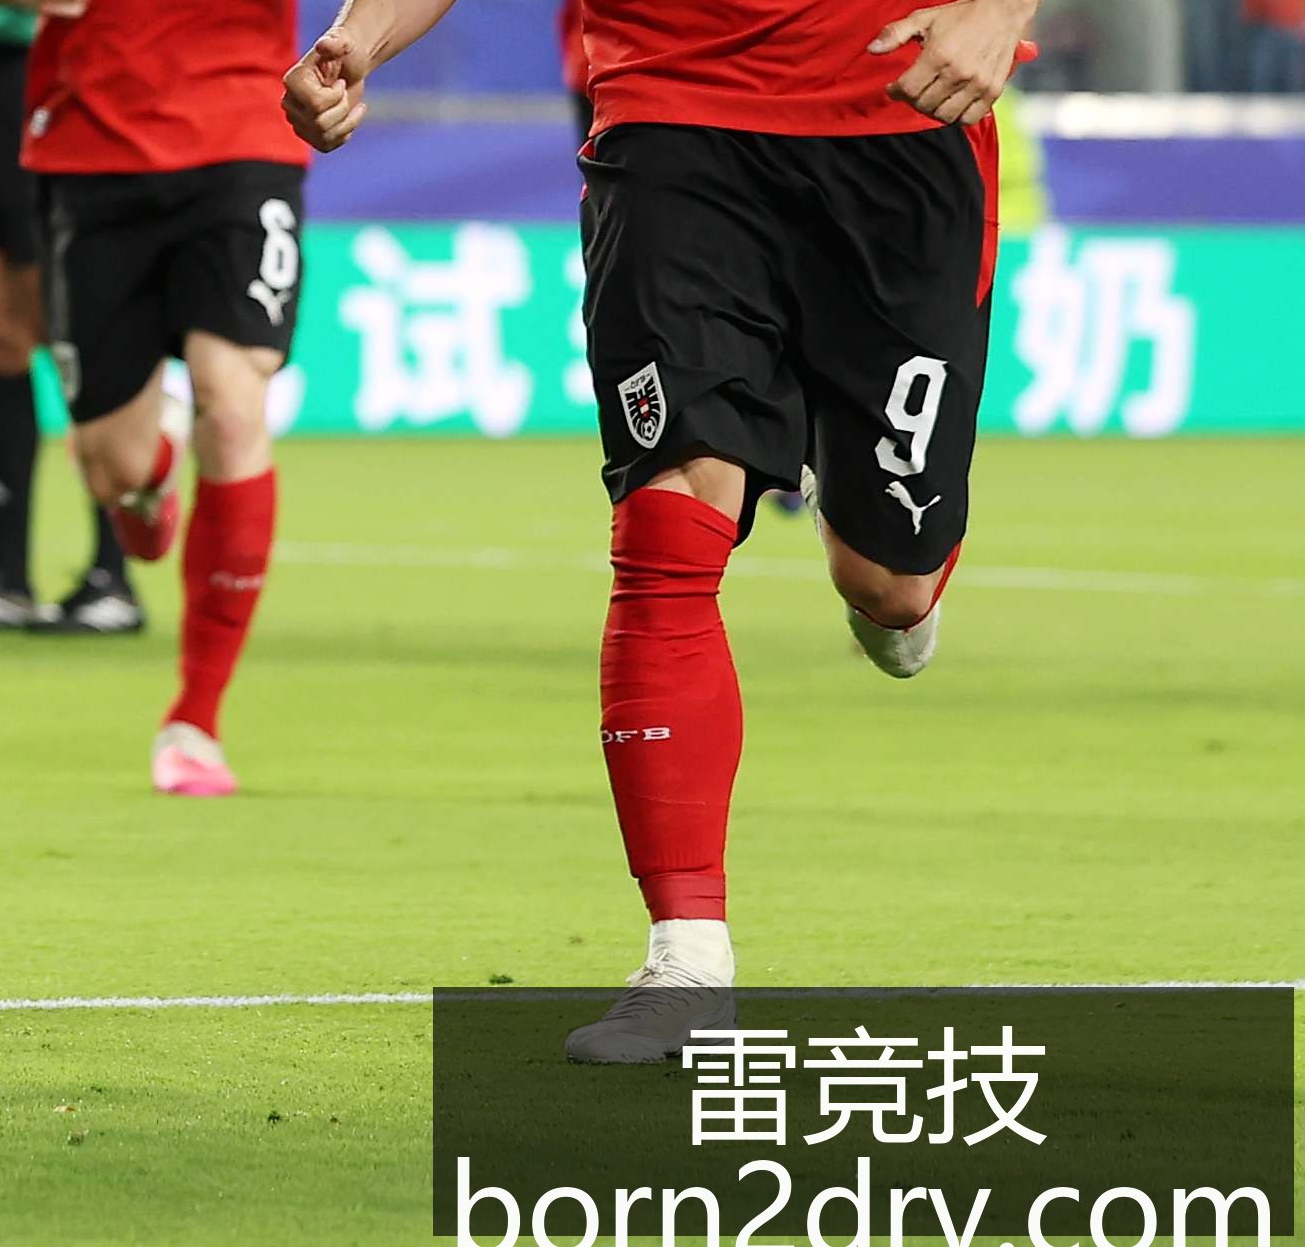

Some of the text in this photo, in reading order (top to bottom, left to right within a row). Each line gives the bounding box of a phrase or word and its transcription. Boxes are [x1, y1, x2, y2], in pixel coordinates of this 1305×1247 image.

[258, 197, 300, 291] 6
[339, 223, 535, 437] 试
[1011, 223, 1197, 439] 奶
[874, 355, 949, 477] 9
